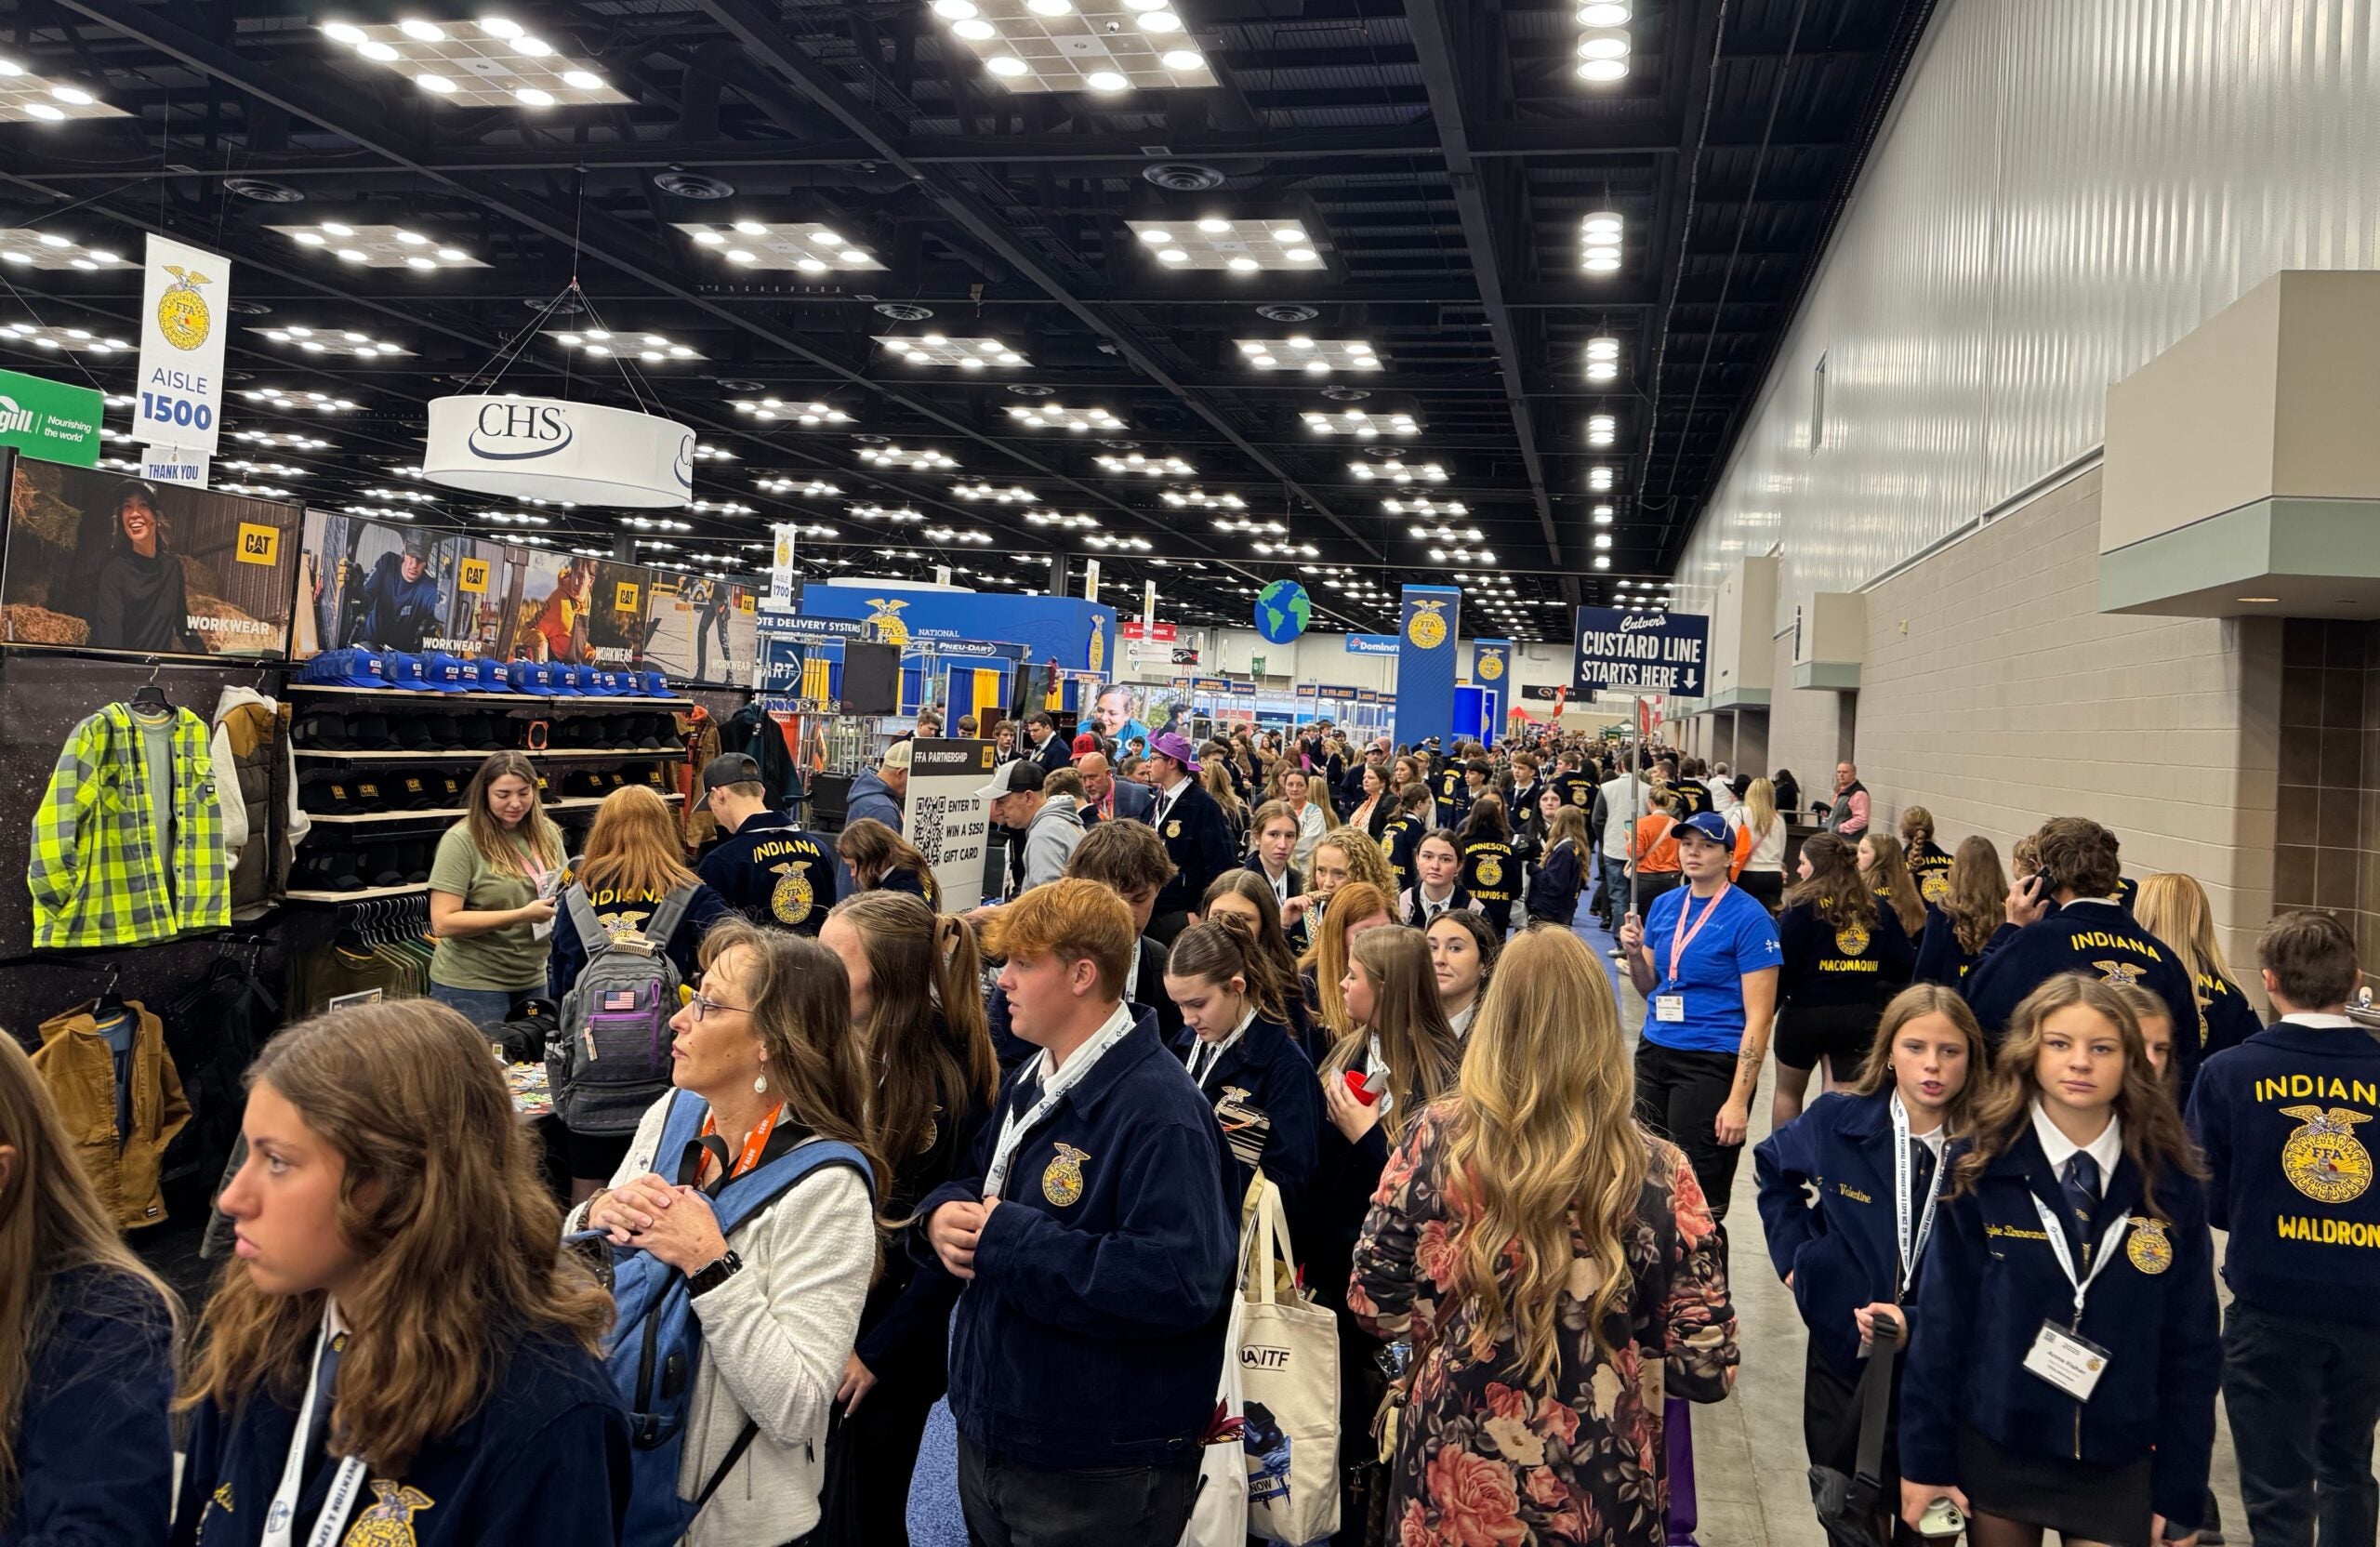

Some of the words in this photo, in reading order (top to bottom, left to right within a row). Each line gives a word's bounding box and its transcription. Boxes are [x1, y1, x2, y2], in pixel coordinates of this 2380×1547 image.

[176, 302, 195, 316] FFA
[152, 367, 207, 395] AISLE
[142, 391, 212, 430] 1500
[47, 415, 92, 434] Nourishing
[479, 403, 562, 441] CHS
[45, 428, 58, 438] the
[60, 430, 84, 443] world
[149, 464, 178, 480] THANK
[180, 466, 199, 480] YOU
[245, 534, 271, 555] CAT
[467, 567, 484, 585] CAT
[775, 575, 789, 584] AISLE
[620, 589, 634, 604] CAT
[773, 585, 789, 598] 1700
[744, 600, 752, 611] CAT
[187, 615, 270, 636] WORKWEAR
[776, 618, 826, 630] DELIVERY
[828, 622, 861, 633] SYSTEMS
[1620, 614, 1666, 632] Culver's
[919, 628, 959, 638] NATIONAL
[422, 637, 482, 653] WORKWEAR
[1582, 630, 1659, 660] CUSTARD
[1663, 637, 1702, 663] LINE
[595, 646, 633, 663] WORKWEAR
[712, 659, 750, 672] WORKWEAR
[1580, 660, 1637, 685] STARTS
[1641, 665, 1679, 688] HERE
[914, 751, 927, 762] FFA
[928, 751, 968, 762] PARTNERSHIP
[984, 751, 993, 762] CAT
[948, 800, 969, 813] ENTER
[972, 799, 980, 811] TO
[946, 825, 959, 838] WIN
[961, 824, 967, 836] A
[969, 822, 985, 835] $250
[753, 840, 820, 864] INDIANA
[944, 850, 959, 863] GIFT
[960, 847, 978, 861] CARD
[1465, 842, 1512, 855] MINNESOTA
[588, 888, 665, 906] NDIAN
[2069, 931, 2162, 963] INDIANA
[2255, 1074, 2380, 1106] INDIAN
[2298, 1139, 2356, 1163] AGRICULTURAL
[2312, 1147, 2344, 1160] FFA
[2305, 1175, 2353, 1190] EDUCATION
[2278, 1214, 2380, 1249] WALDRON
[1262, 1350, 1289, 1367] ITF
[333, 1460, 360, 1513] NVENTION
[317, 1525, 333, 1547] EXP
